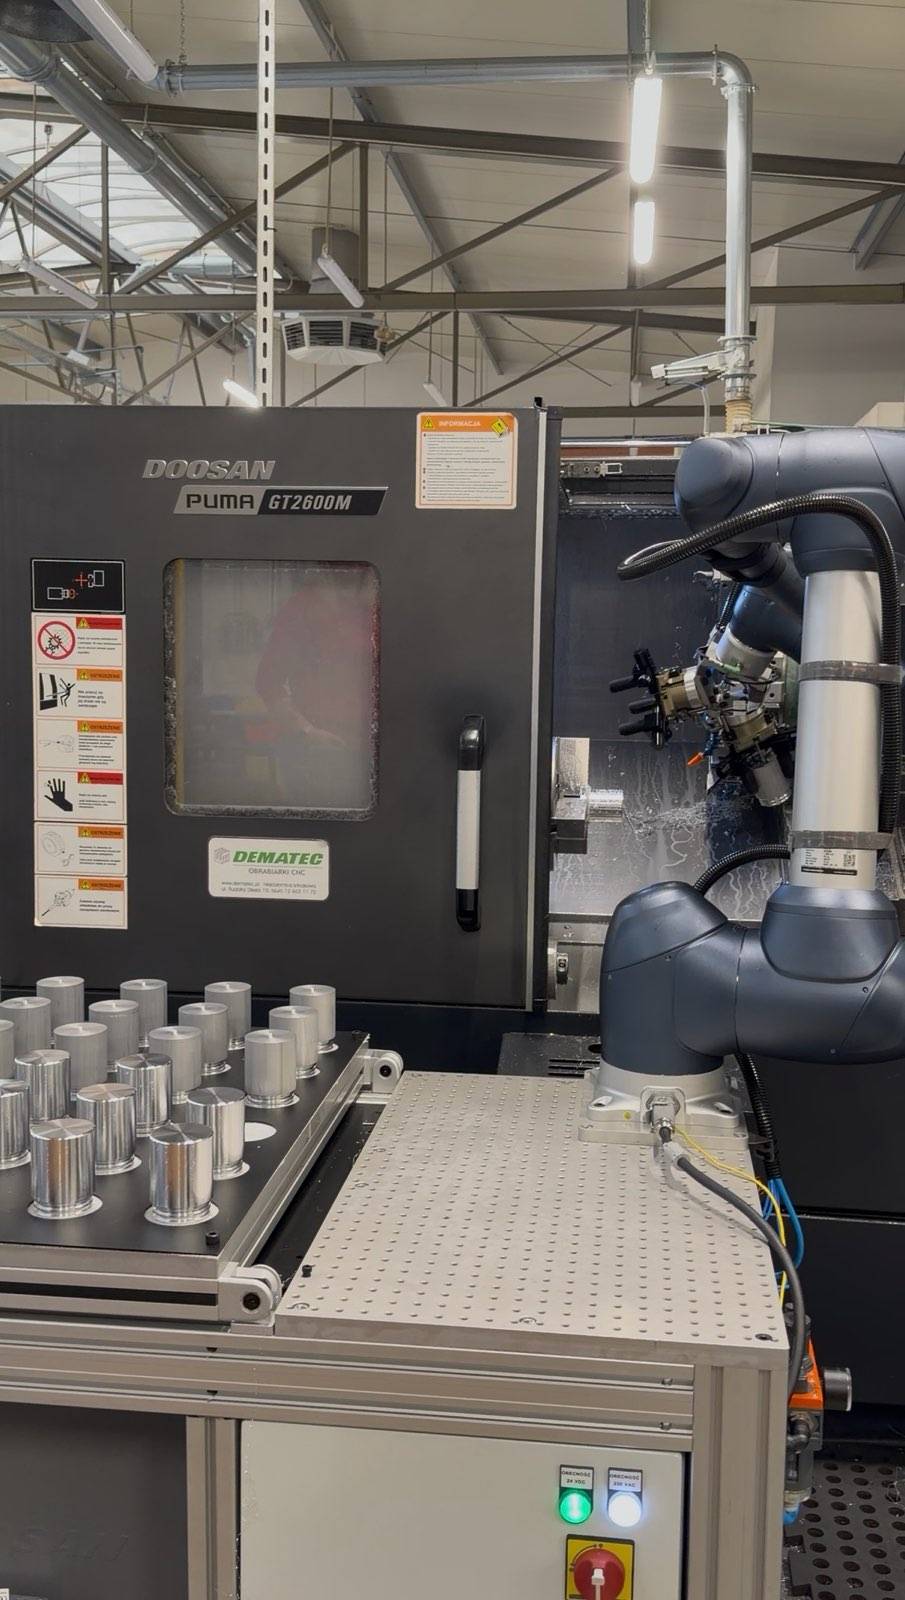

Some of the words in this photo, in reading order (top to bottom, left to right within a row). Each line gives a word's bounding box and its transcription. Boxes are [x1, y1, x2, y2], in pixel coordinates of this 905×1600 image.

[142, 459, 276, 480] DOOSAN
[186, 493, 254, 509] PUMA
[268, 493, 352, 511] GT2600M
[233, 851, 323, 865] DEMATEC
[291, 868, 306, 876] CNC
